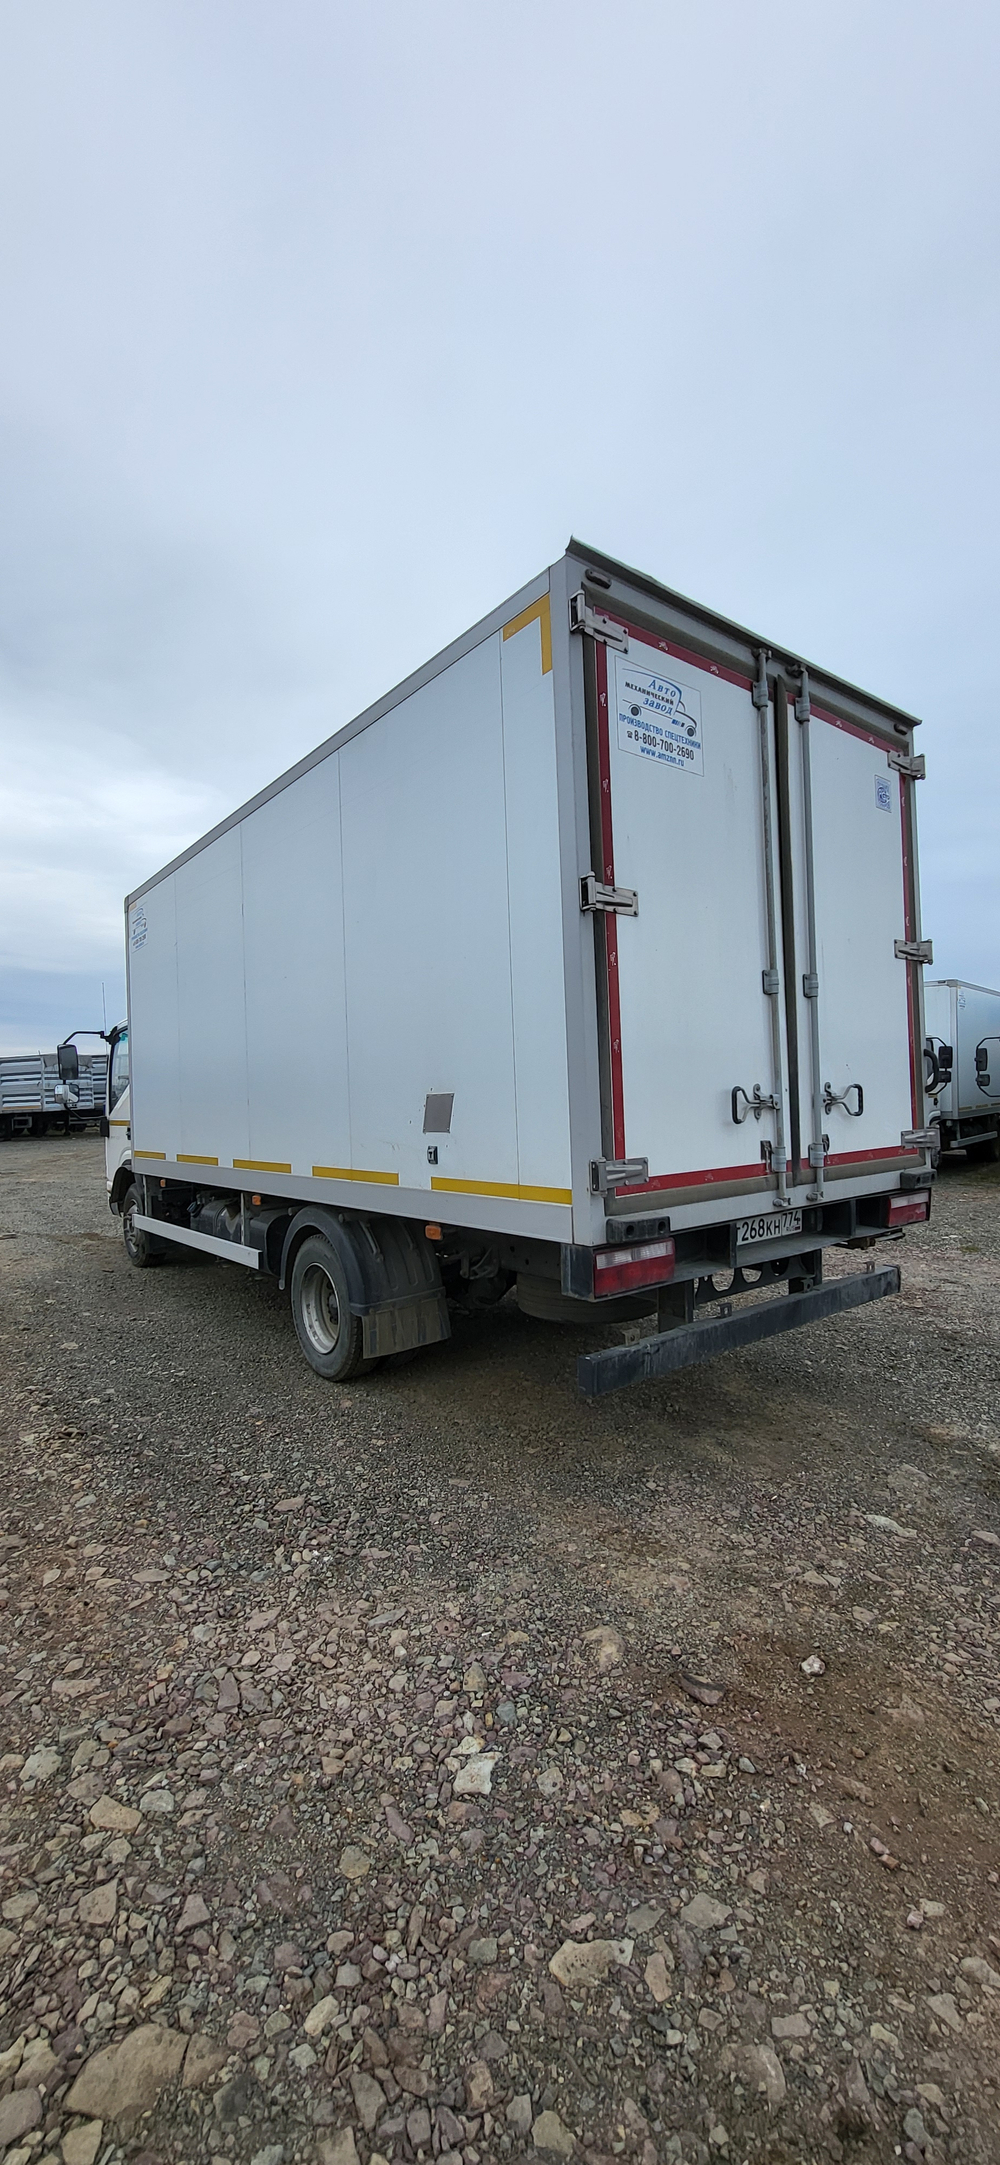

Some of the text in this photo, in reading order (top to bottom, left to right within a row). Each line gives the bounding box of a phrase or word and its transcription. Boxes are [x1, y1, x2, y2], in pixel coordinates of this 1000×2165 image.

[625, 681, 674, 706] МЕХАНИЧЕСКИЙ
[619, 713, 663, 736] ПРОИЗВОДСТВО
[664, 729, 701, 750] СПЕЦТЕХНИКИ
[634, 730, 694, 760] 8-800-700-2690
